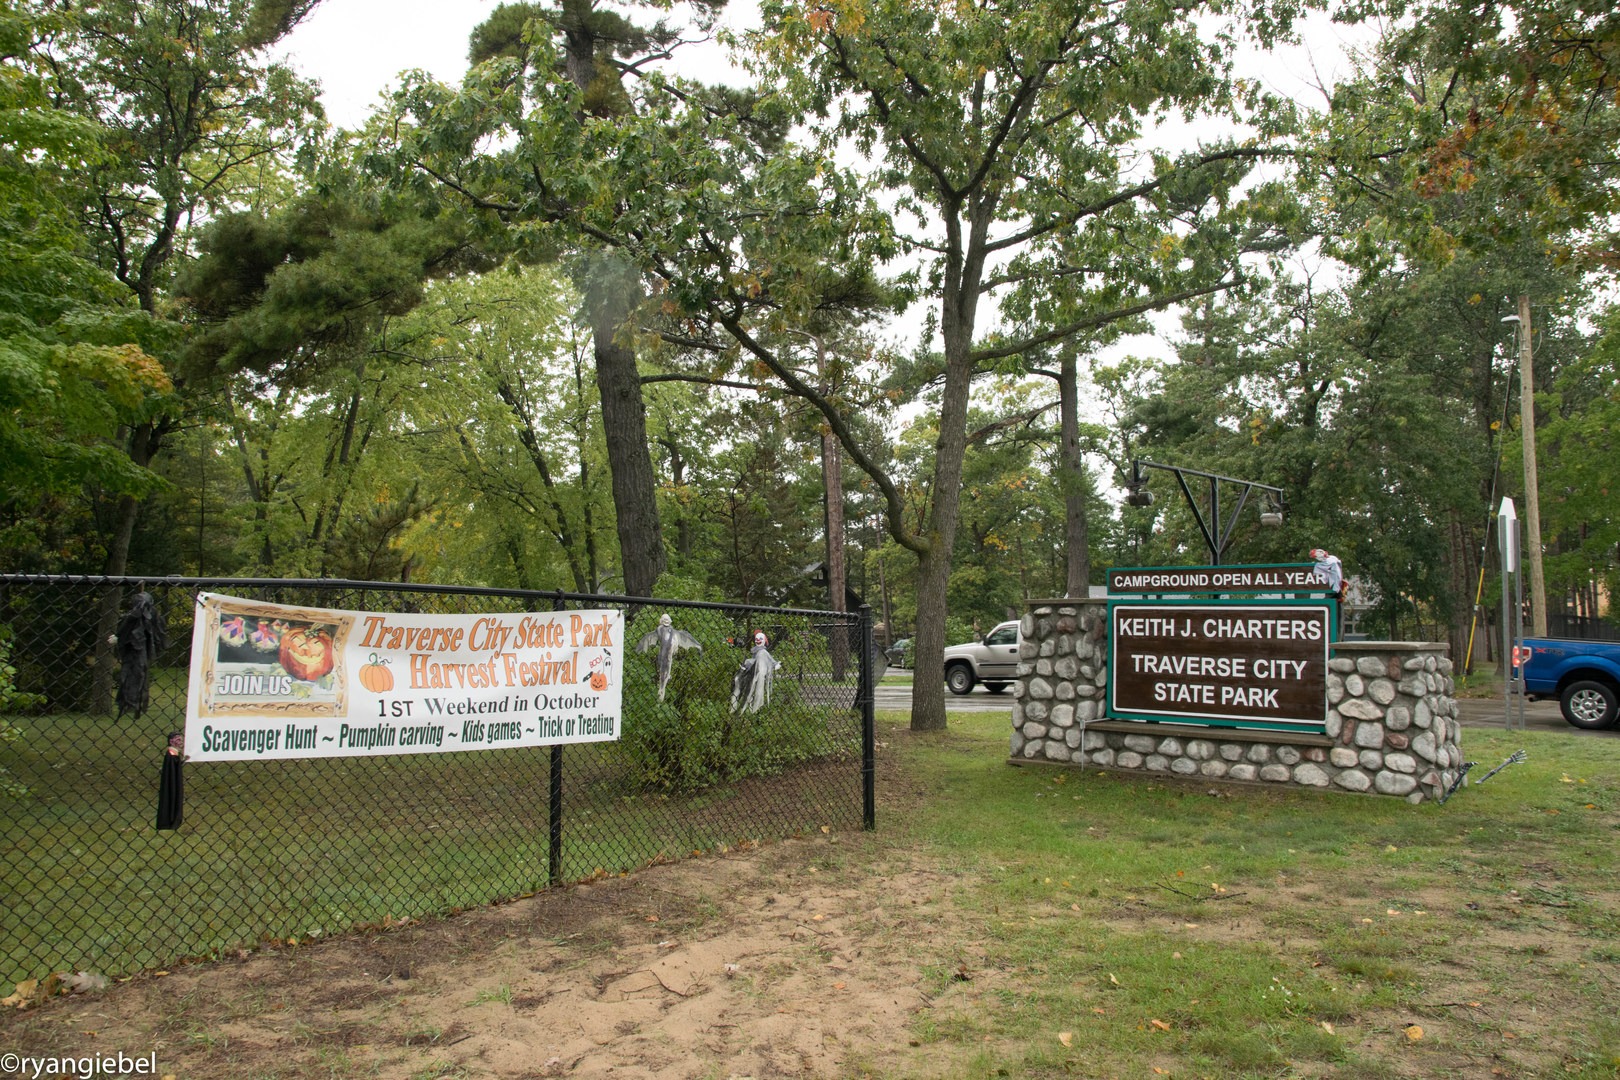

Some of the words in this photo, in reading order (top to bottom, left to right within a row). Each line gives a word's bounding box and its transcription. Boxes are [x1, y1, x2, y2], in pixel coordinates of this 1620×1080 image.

[1114, 573, 1208, 588] CAMPGROUND
[1212, 573, 1251, 586] OPEN
[1254, 572, 1282, 586] ALL
[1285, 572, 1327, 585] YEAR
[359, 616, 464, 652] Traverse
[468, 617, 514, 659] City
[513, 616, 564, 649] State
[570, 614, 613, 647] Park
[1119, 618, 1175, 637] KEITH
[1180, 619, 1196, 638] J.
[1203, 619, 1322, 640] CHARTERS
[409, 653, 499, 689] Harvest
[501, 651, 578, 687] Festival
[1131, 654, 1246, 678] TRAVERSE
[1253, 658, 1307, 680] CITY
[218, 674, 263, 695] JOIN
[268, 675, 293, 695] US
[1154, 682, 1215, 704] STATE
[1221, 686, 1279, 709] PARK
[424, 696, 509, 716] Weekend
[513, 695, 528, 712] in
[534, 693, 600, 711] October
[202, 725, 282, 754] Scavenger
[284, 724, 318, 750] Hunt
[339, 723, 396, 751] Pumpkin
[399, 722, 445, 747] carving
[461, 720, 486, 743] Kids
[487, 720, 522, 744] games
[538, 715, 563, 738] Trick
[565, 717, 576, 736] or
[577, 713, 615, 736] Treating
